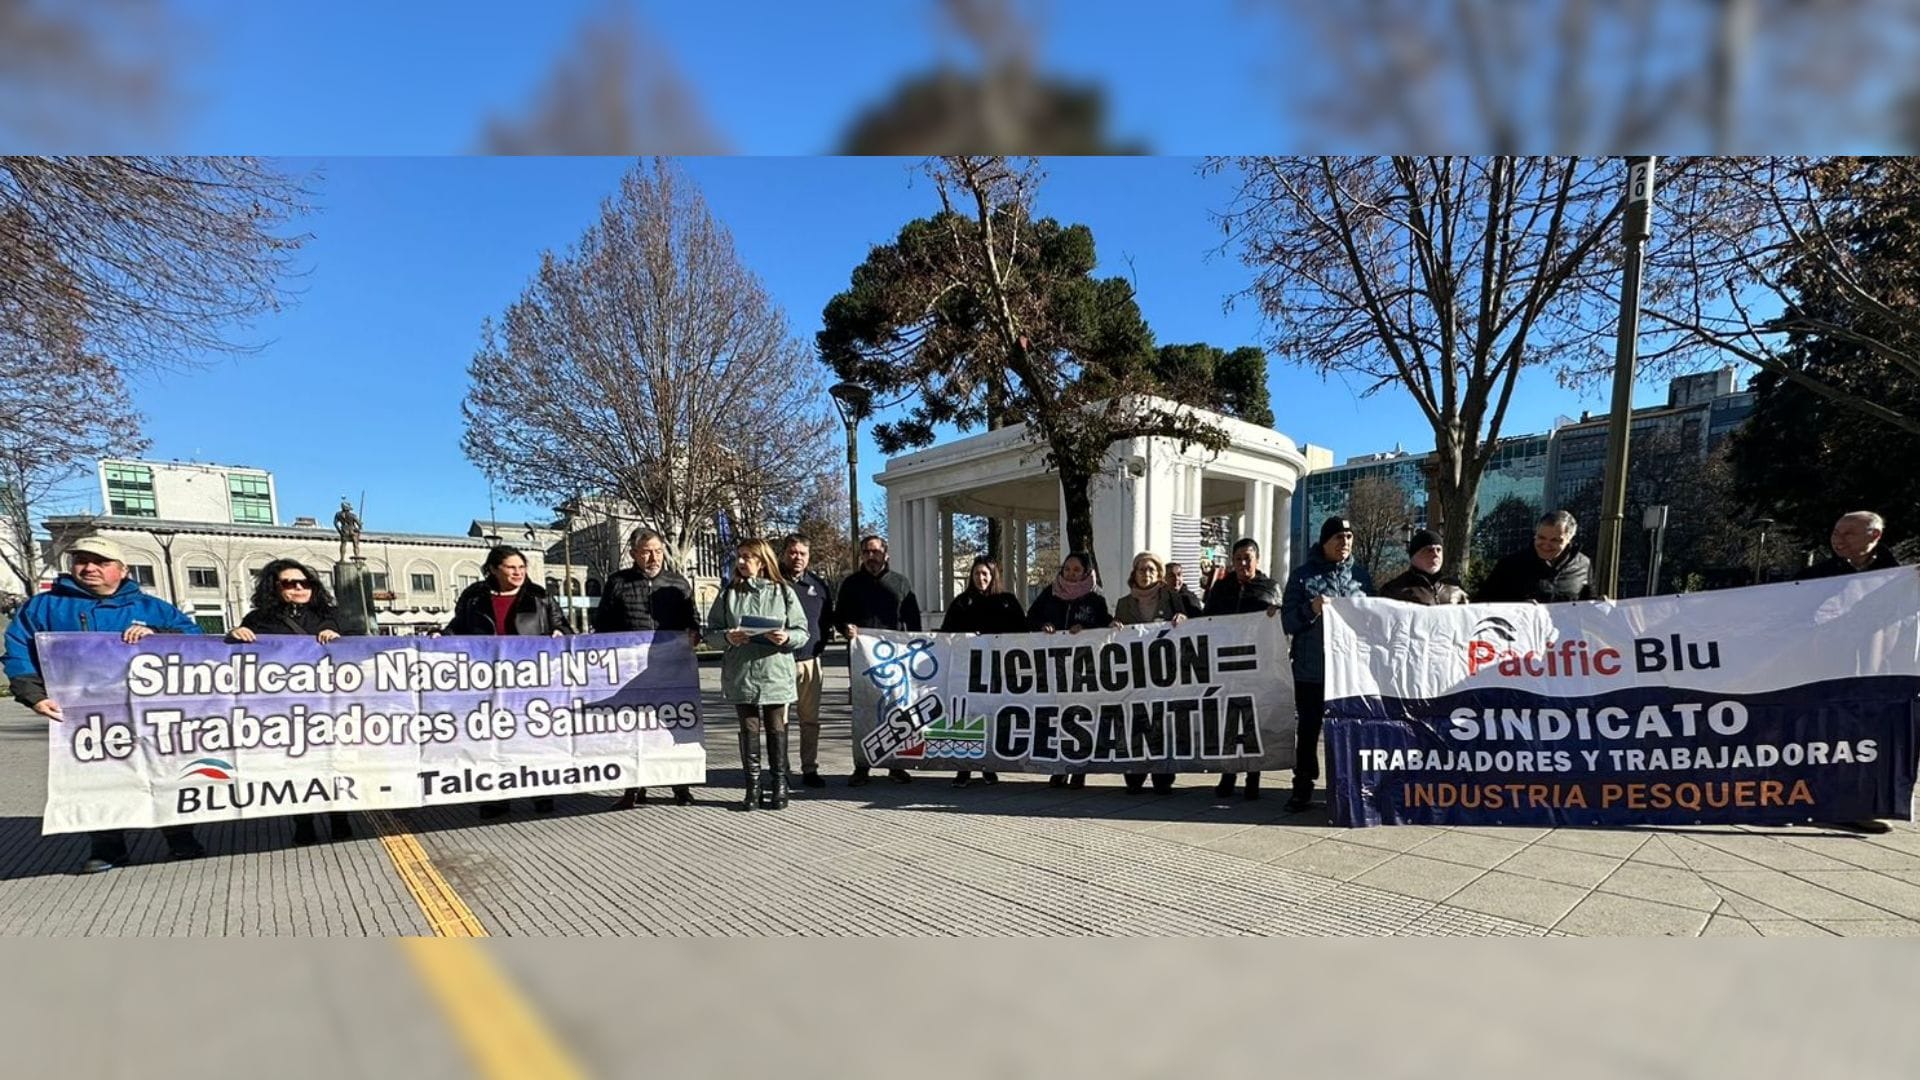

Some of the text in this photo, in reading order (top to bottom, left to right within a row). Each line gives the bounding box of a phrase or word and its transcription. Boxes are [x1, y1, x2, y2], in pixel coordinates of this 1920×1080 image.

[128, 654, 363, 695] Sindicato
[375, 649, 550, 691] Nacional
[1467, 633, 1720, 677] Pacific Blu
[74, 697, 697, 761] de Trabajadores de Salmones
[997, 686, 1262, 758] CESANTÍA
[1450, 701, 1748, 740] SINDICATO
[1359, 740, 1878, 772] TRABAJADORES Y TRABAJADORAS
[176, 776, 359, 814] BLUMAR
[417, 761, 622, 796] Talcahuano
[1404, 781, 1814, 810] INDUSTRIA PESQUERA
